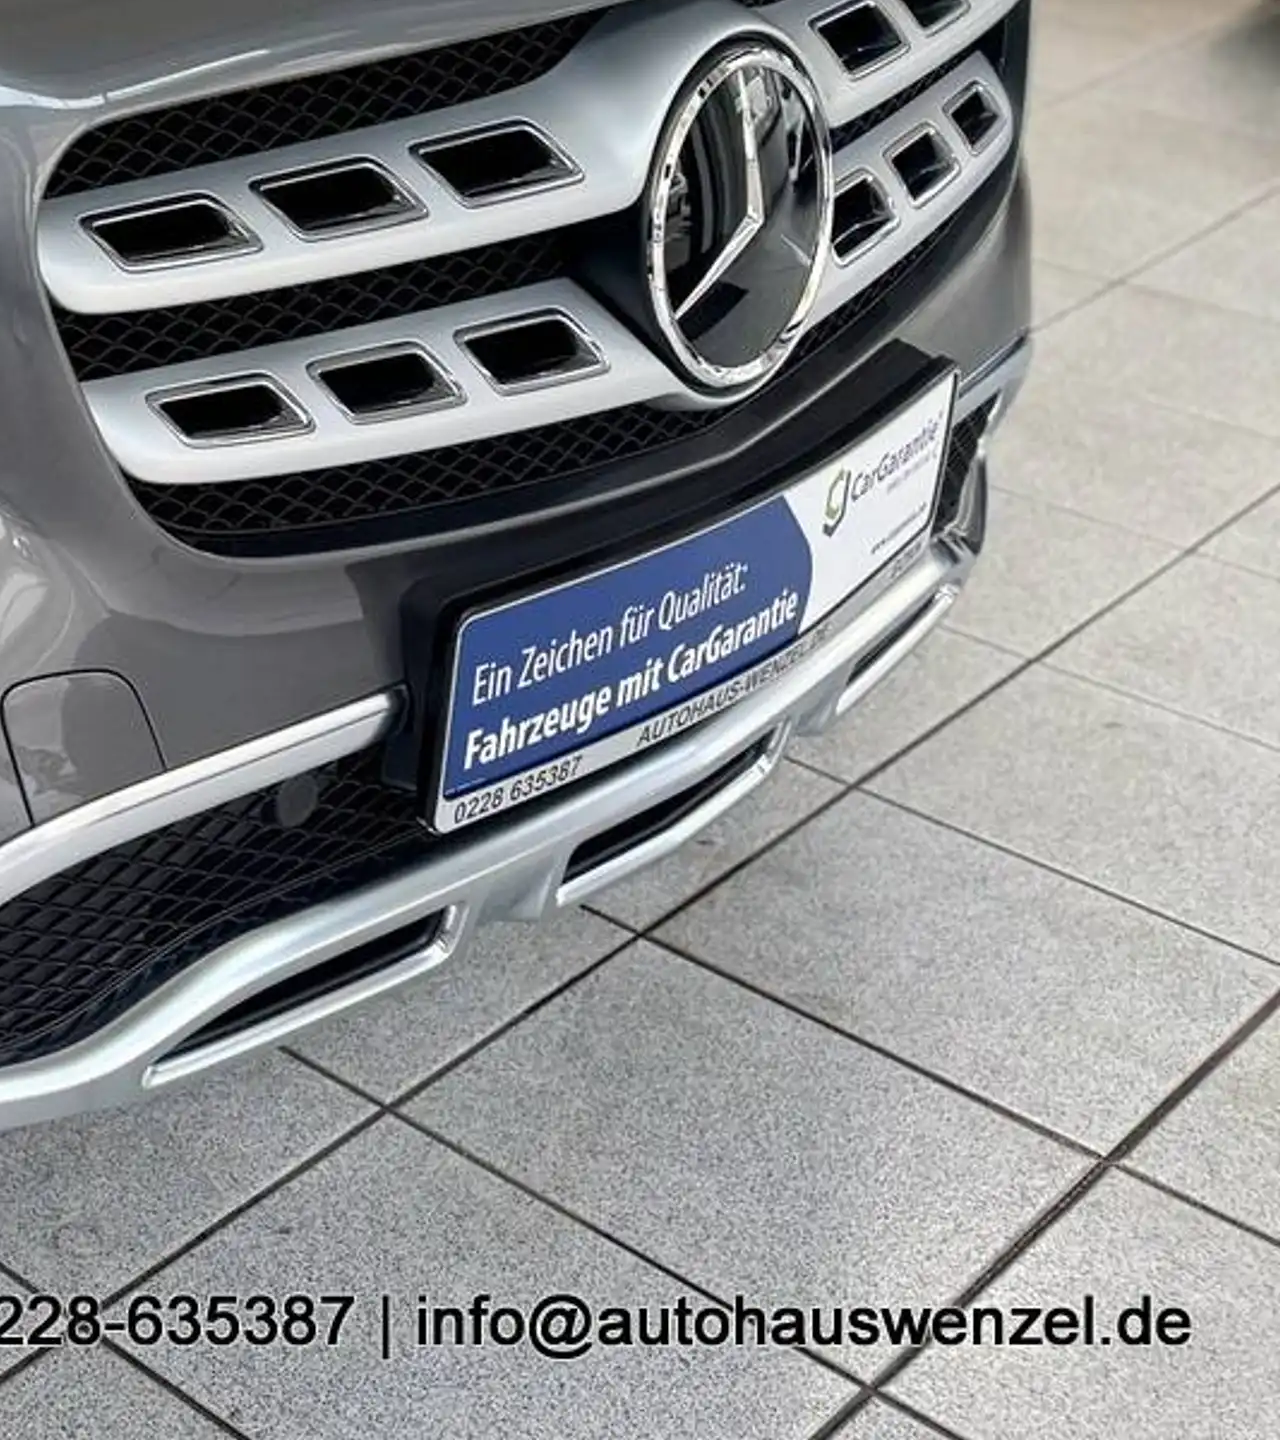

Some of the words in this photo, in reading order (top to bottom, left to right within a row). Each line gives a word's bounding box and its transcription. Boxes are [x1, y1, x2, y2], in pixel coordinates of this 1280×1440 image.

[463, 691, 611, 770] Fahrzeuge
[616, 656, 664, 707] mit
[667, 587, 799, 683] CarGarantie
[472, 662, 512, 706] Ein
[517, 625, 612, 690] Zeichen
[618, 604, 655, 648] für
[658, 562, 749, 630] Qualität:
[453, 787, 504, 825] 0228
[510, 755, 584, 803] 635387
